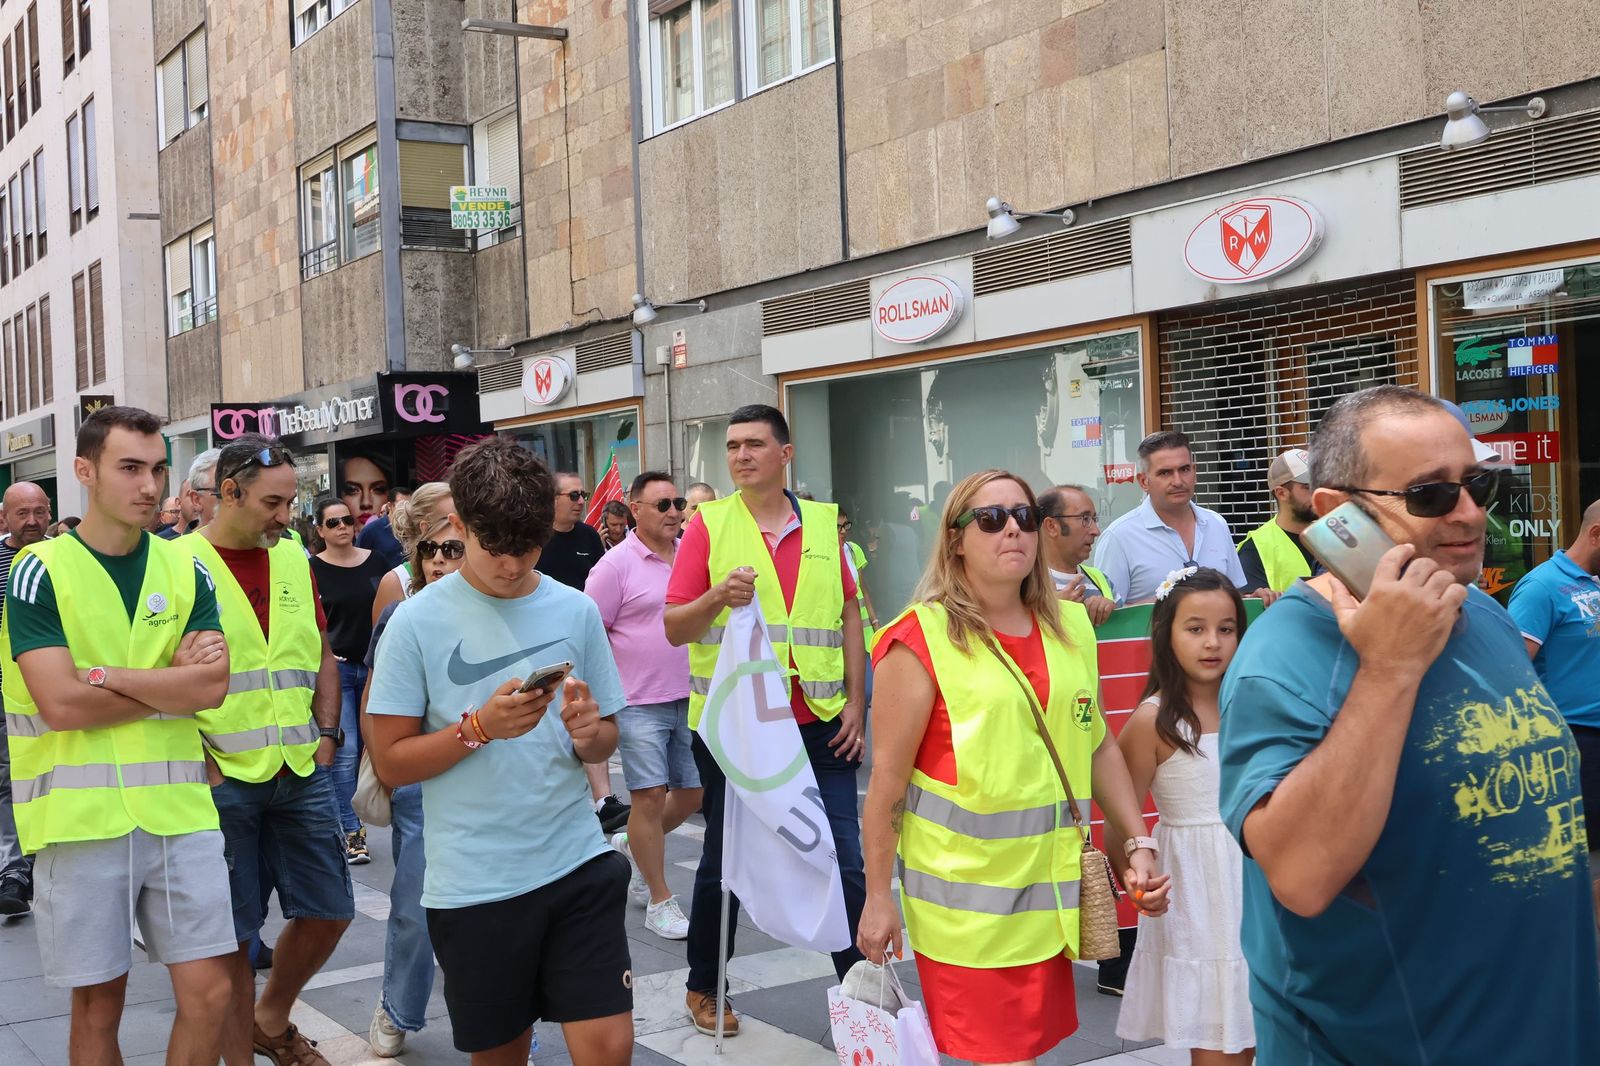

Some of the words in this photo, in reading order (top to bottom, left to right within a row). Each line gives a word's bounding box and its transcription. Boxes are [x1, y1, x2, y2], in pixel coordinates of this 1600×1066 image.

[470, 188, 507, 197] REYNA
[459, 202, 506, 210] VENDE
[879, 293, 949, 325] ROLLSMAN
[1509, 336, 1555, 347] TOMMY
[1456, 367, 1503, 381] LACOSTE
[1509, 364, 1556, 376] HILFIGER
[1469, 411, 1504, 424] LSMAN
[1537, 434, 1552, 459] it
[1510, 493, 1560, 513] KIDS
[1509, 519, 1562, 537] ONLY
[1486, 534, 1507, 545] Klein
